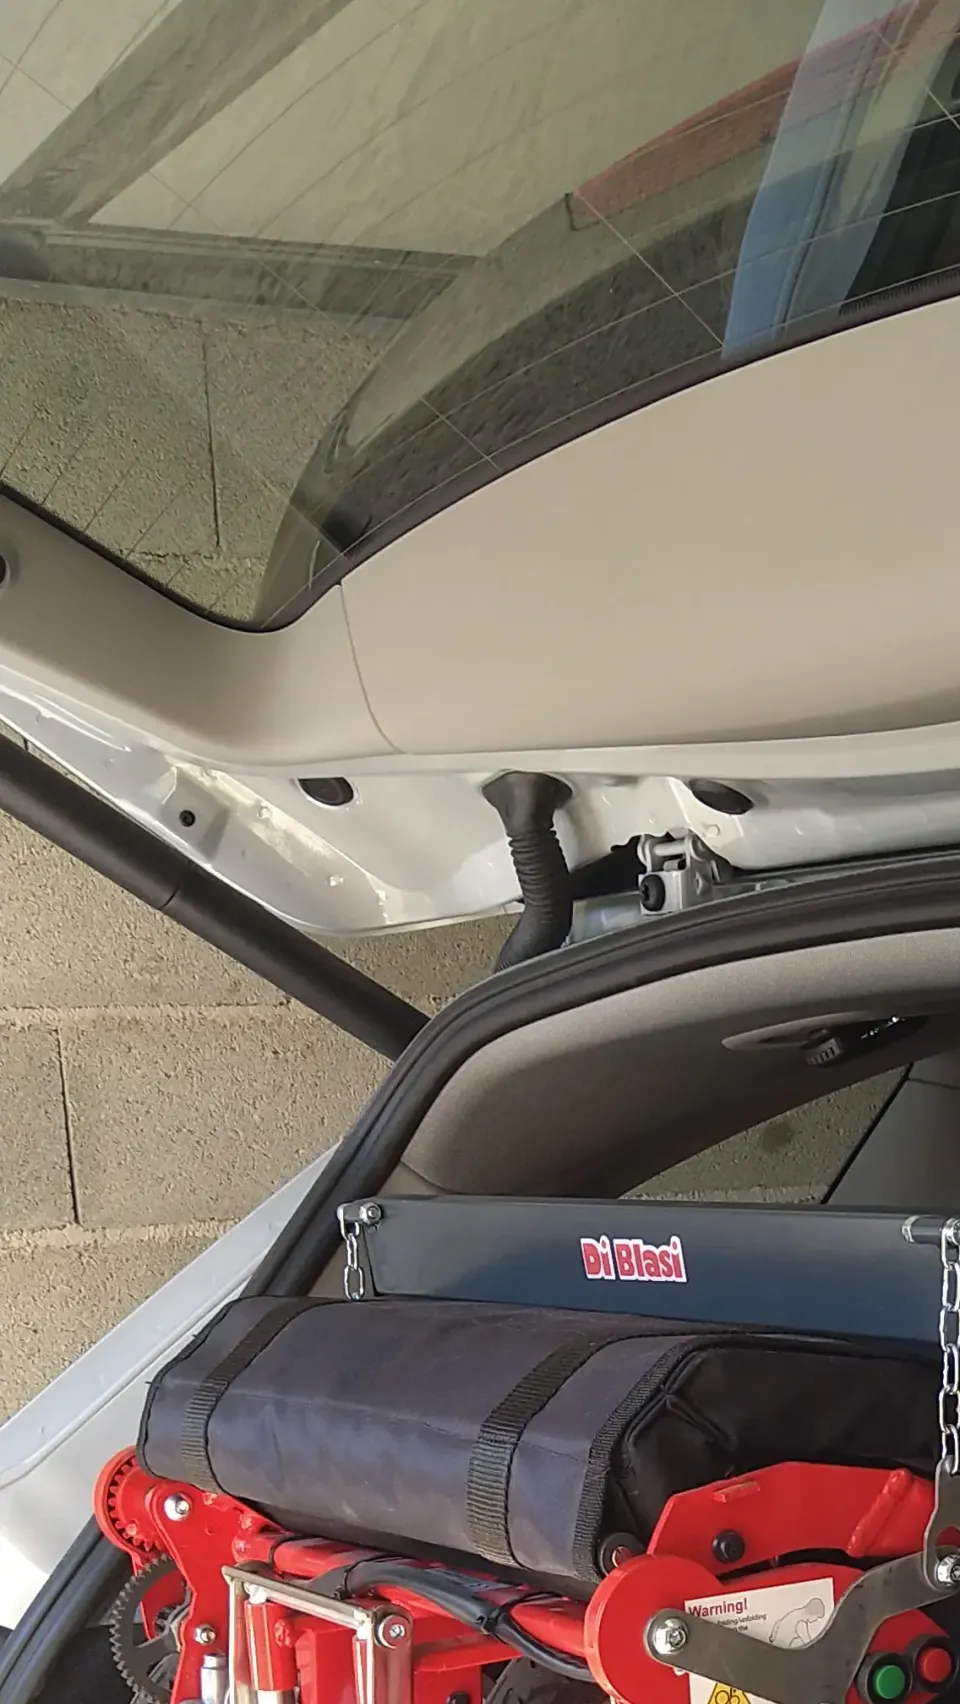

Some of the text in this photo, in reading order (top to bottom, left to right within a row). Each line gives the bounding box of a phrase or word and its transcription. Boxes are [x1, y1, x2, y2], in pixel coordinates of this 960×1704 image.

[580, 1235, 688, 1282] Di Blasi
[688, 1598, 748, 1618] Warning!
